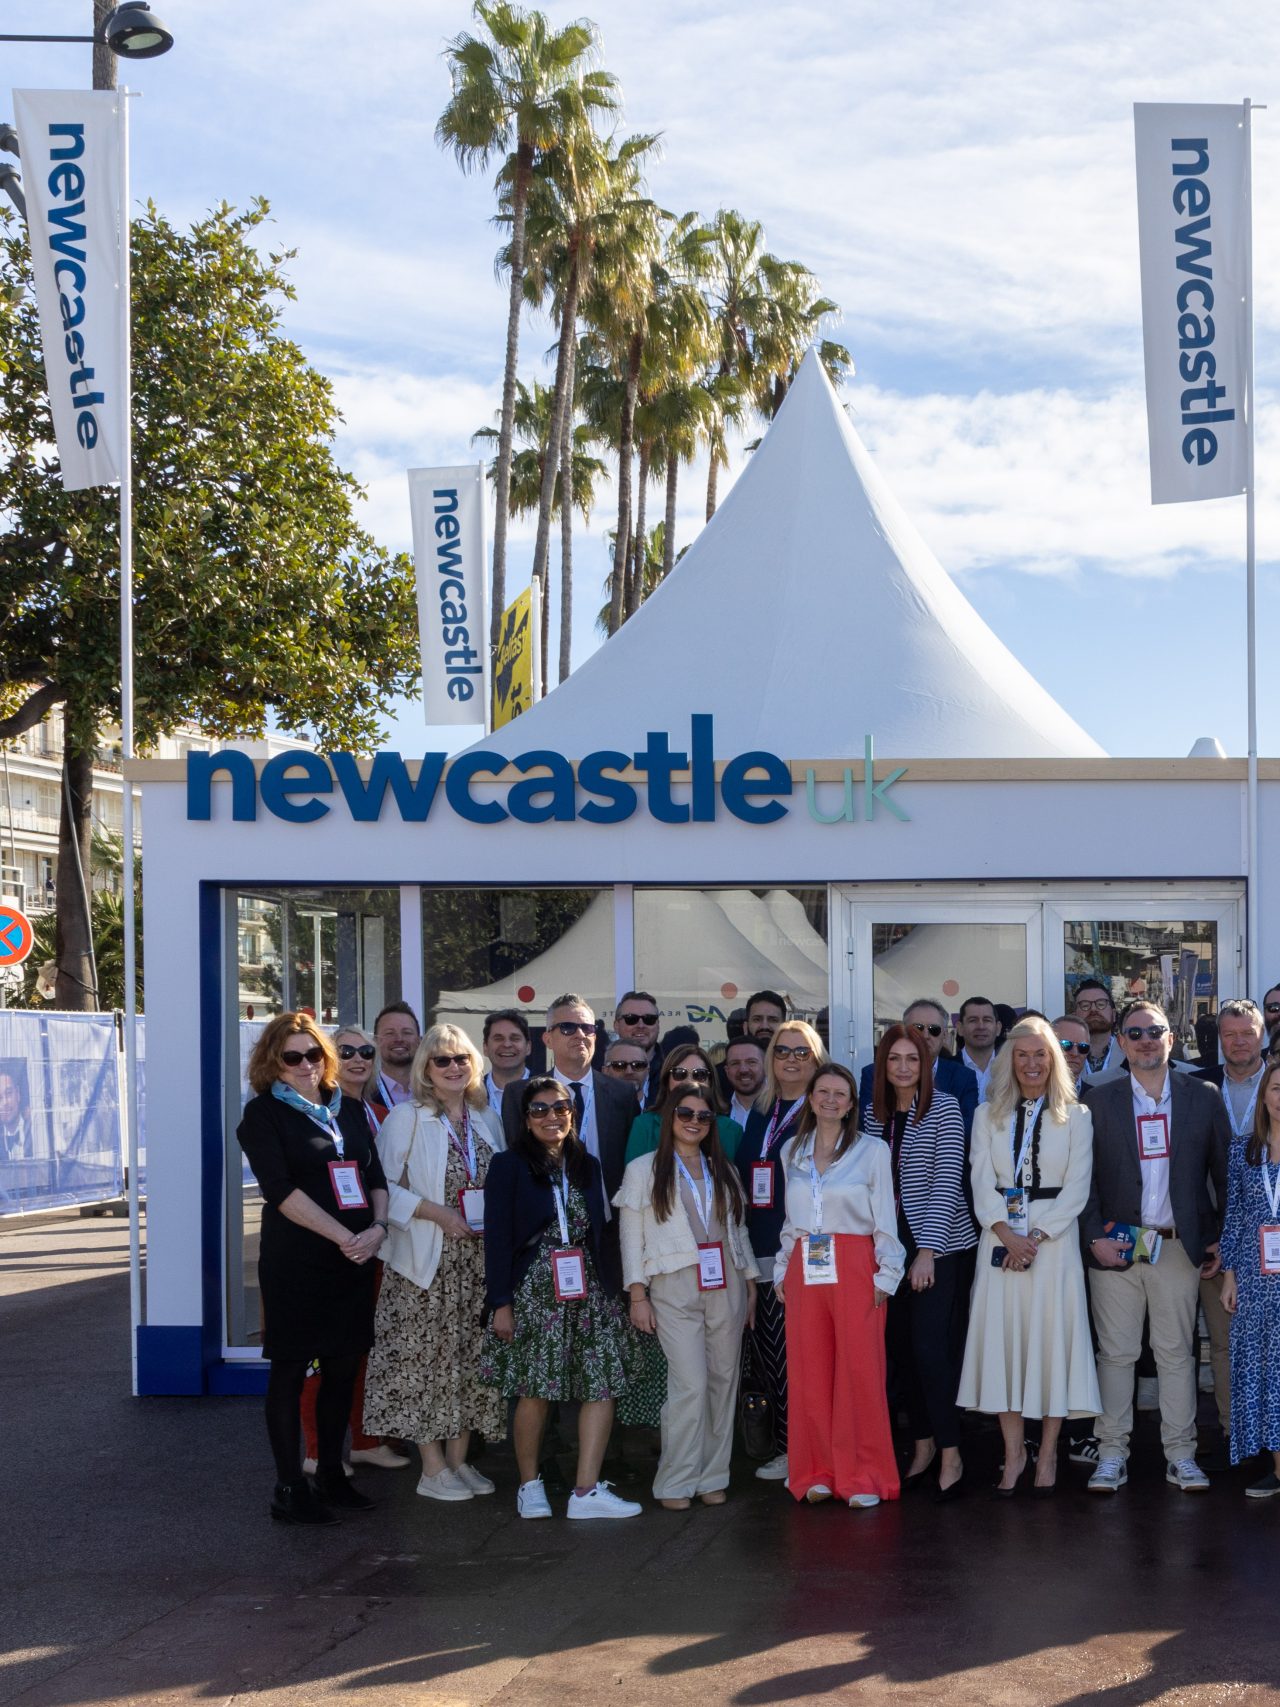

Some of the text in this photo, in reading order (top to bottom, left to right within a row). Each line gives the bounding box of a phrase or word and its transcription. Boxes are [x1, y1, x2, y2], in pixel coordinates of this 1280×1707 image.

[48, 123, 105, 449] newcastle
[1171, 137, 1236, 466] newcastle
[432, 488, 484, 702] newcastle
[187, 713, 911, 825] newcastle uk
